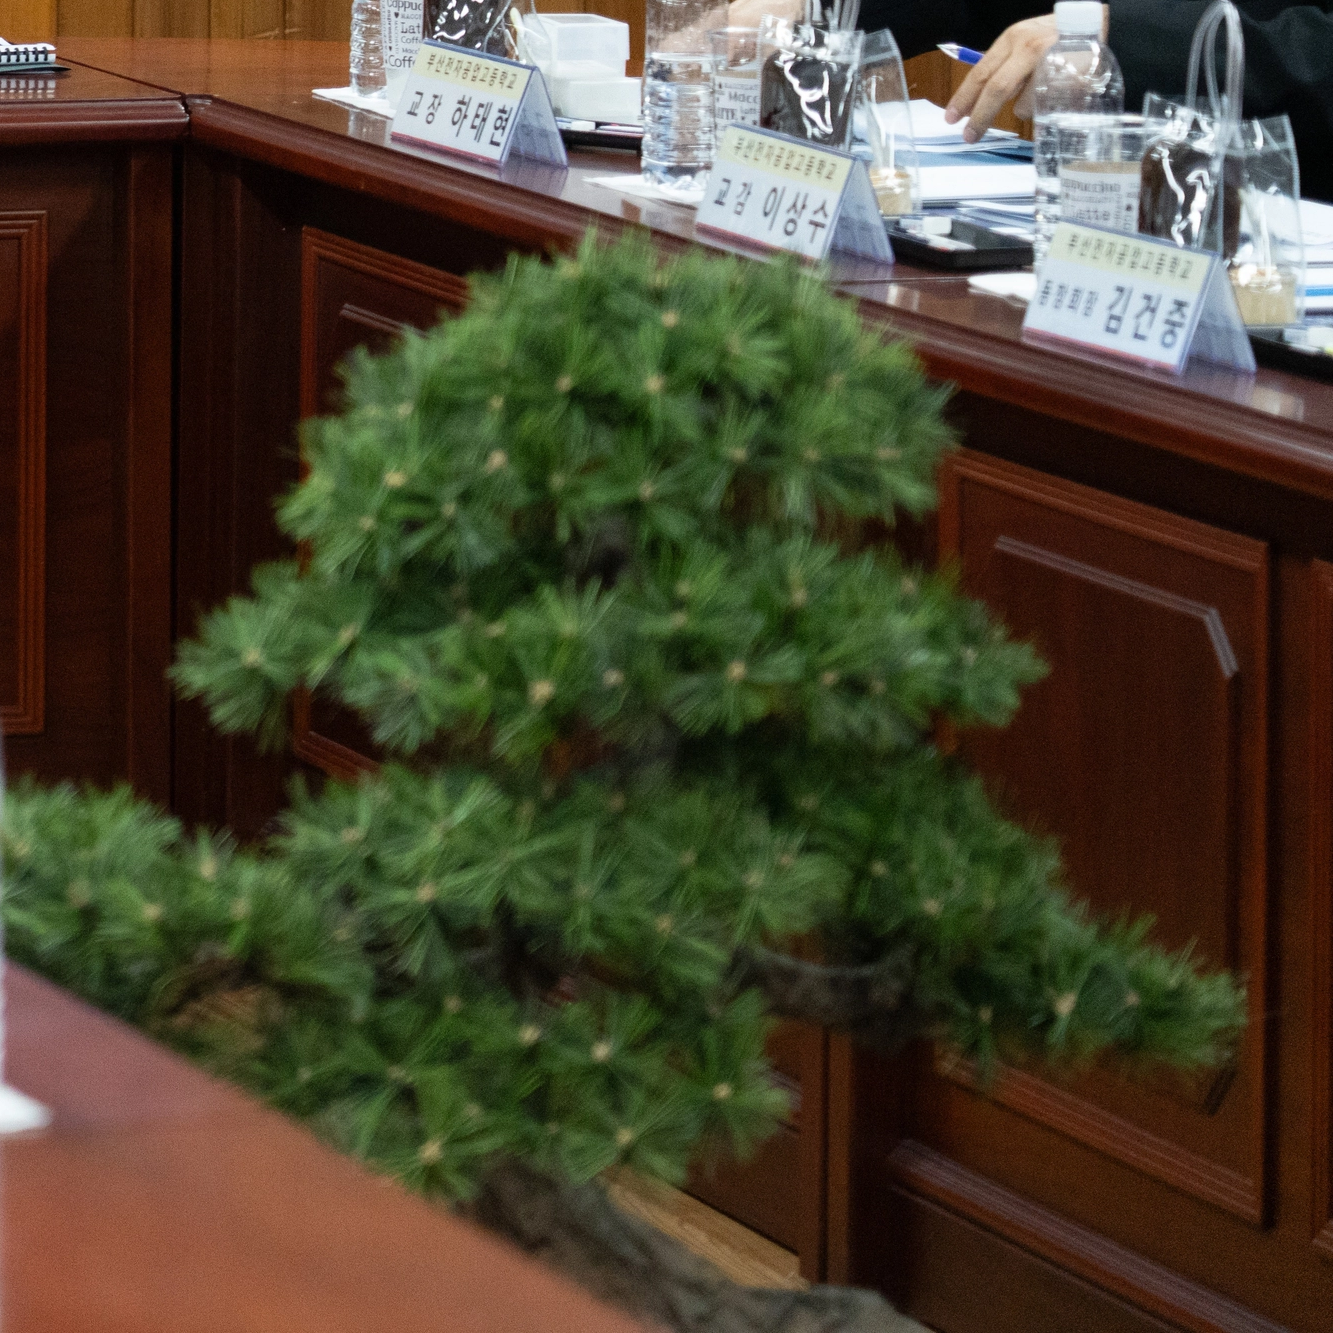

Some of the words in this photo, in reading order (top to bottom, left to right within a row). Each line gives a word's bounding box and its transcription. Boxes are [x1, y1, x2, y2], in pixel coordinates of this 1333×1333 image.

[427, 54, 518, 90] 부산전자공업고등학교
[407, 91, 443, 124] 교장
[451, 94, 513, 147] 하태현
[714, 177, 753, 216] 교감
[763, 186, 829, 244] 이상수
